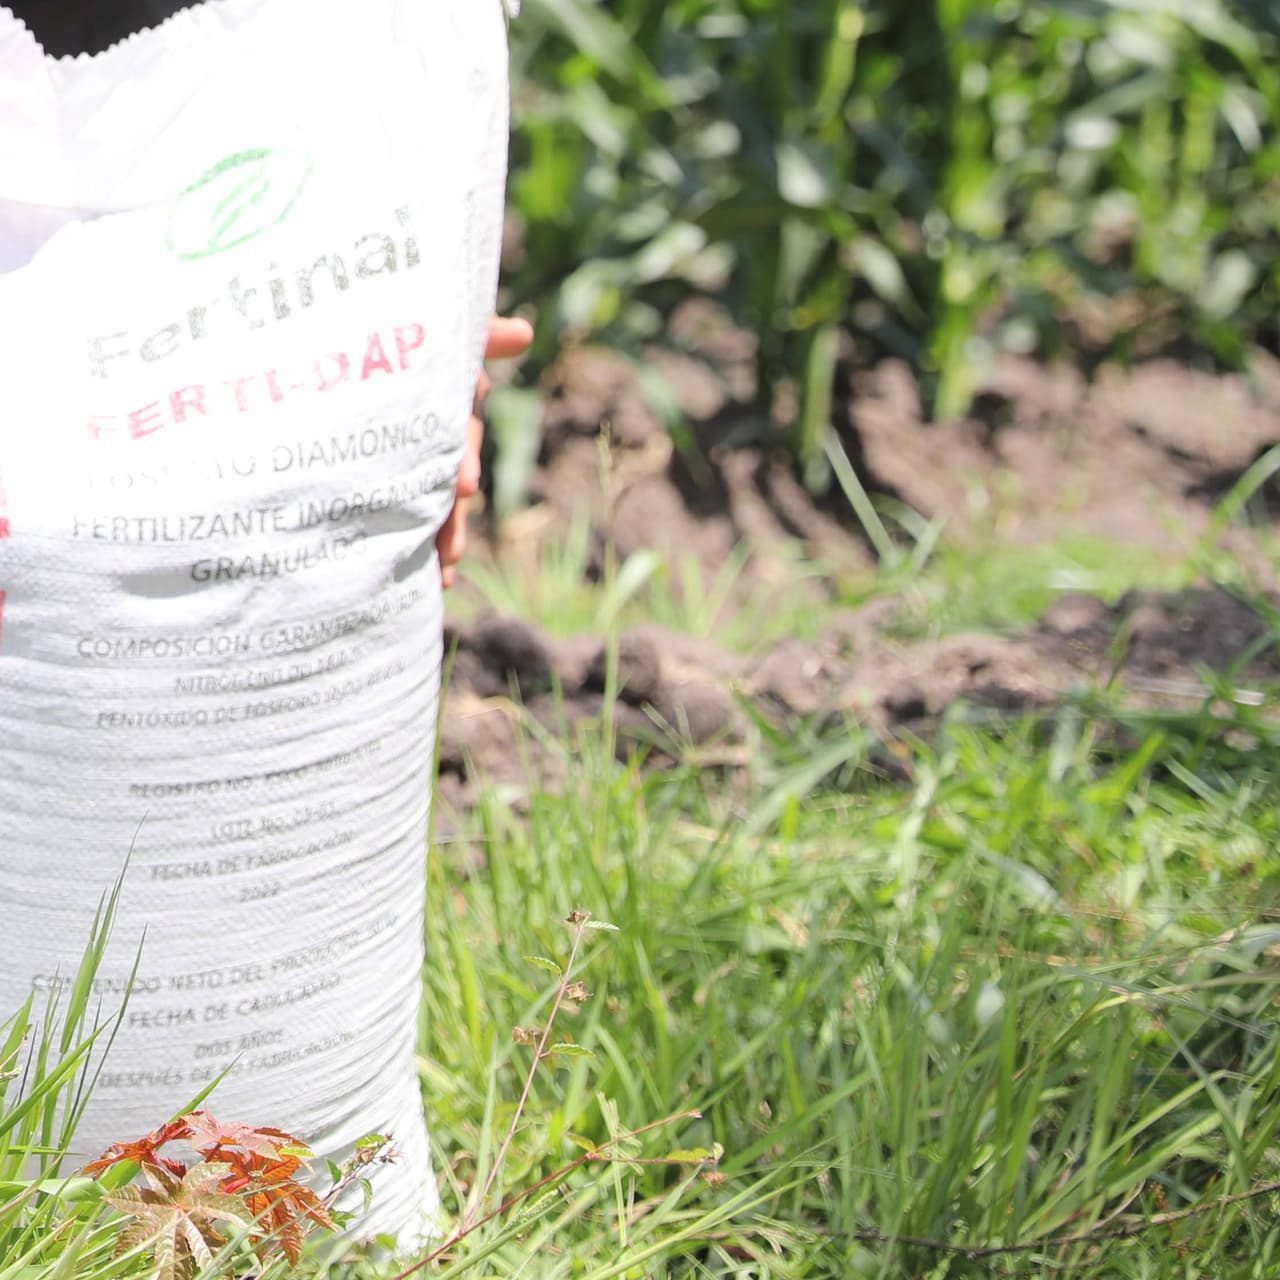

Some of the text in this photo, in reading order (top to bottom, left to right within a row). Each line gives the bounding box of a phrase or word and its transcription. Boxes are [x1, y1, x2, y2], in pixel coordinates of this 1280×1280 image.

[72, 503, 289, 545] FERTILIZANTE
[190, 530, 369, 584] GRANULADO
[30, 973, 163, 996] CONENIDO
[167, 972, 225, 993] NETO
[129, 1006, 196, 1030] FECHA
[202, 1003, 231, 1023] DE
